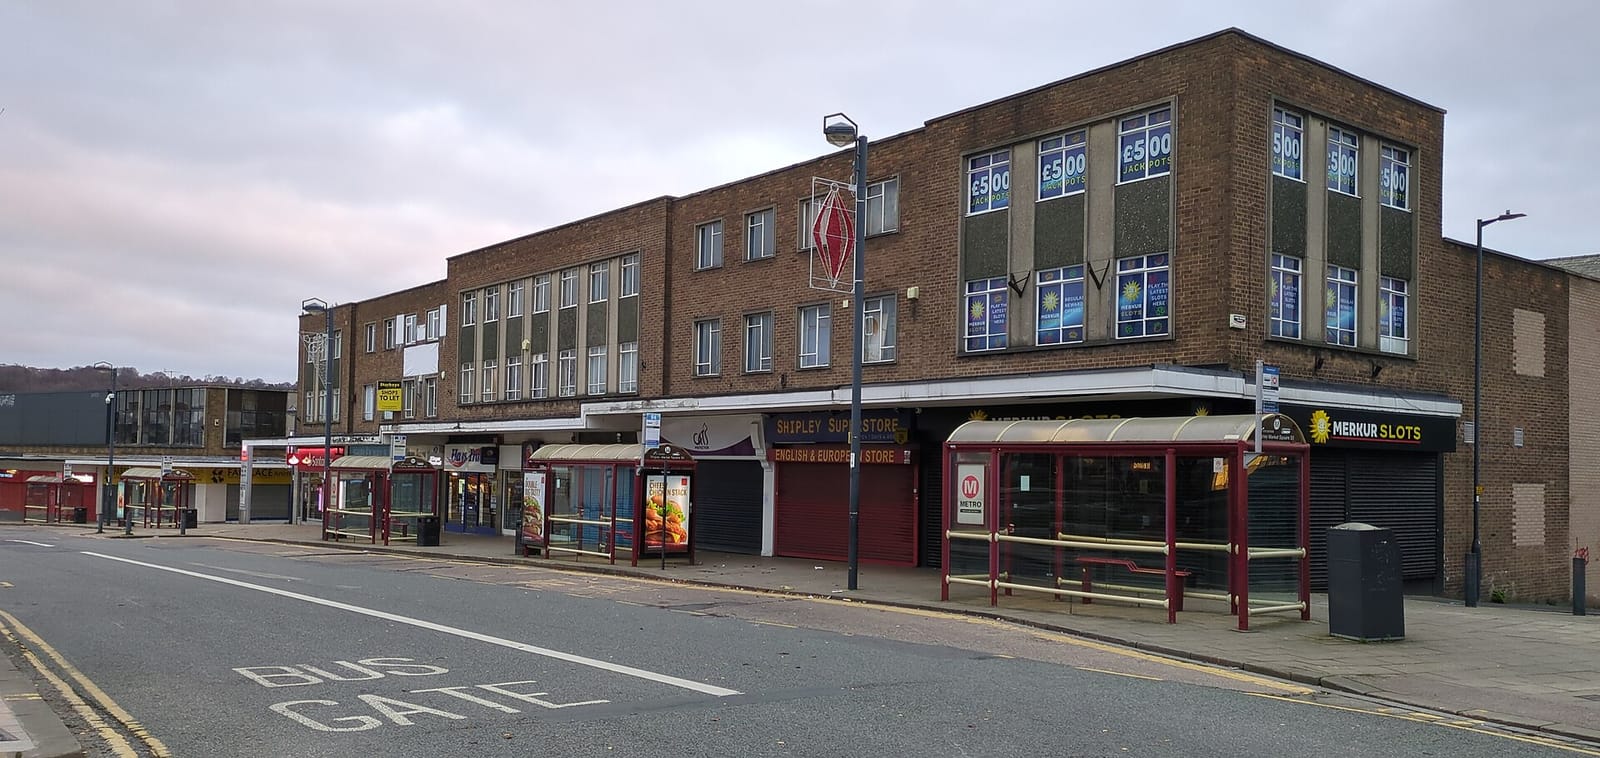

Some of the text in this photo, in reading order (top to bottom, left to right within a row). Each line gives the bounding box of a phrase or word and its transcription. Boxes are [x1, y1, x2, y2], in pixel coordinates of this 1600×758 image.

[1273, 132, 1300, 160] 500
[777, 419, 822, 434] SHIPLEY
[1332, 421, 1421, 440] MERKUR SLOTS
[775, 449, 808, 462] ENGLISH
[809, 450, 815, 462] &
[865, 449, 895, 463] STORE
[960, 500, 982, 508] METRO
[232, 657, 449, 687] BUS
[268, 680, 610, 732] GATE
